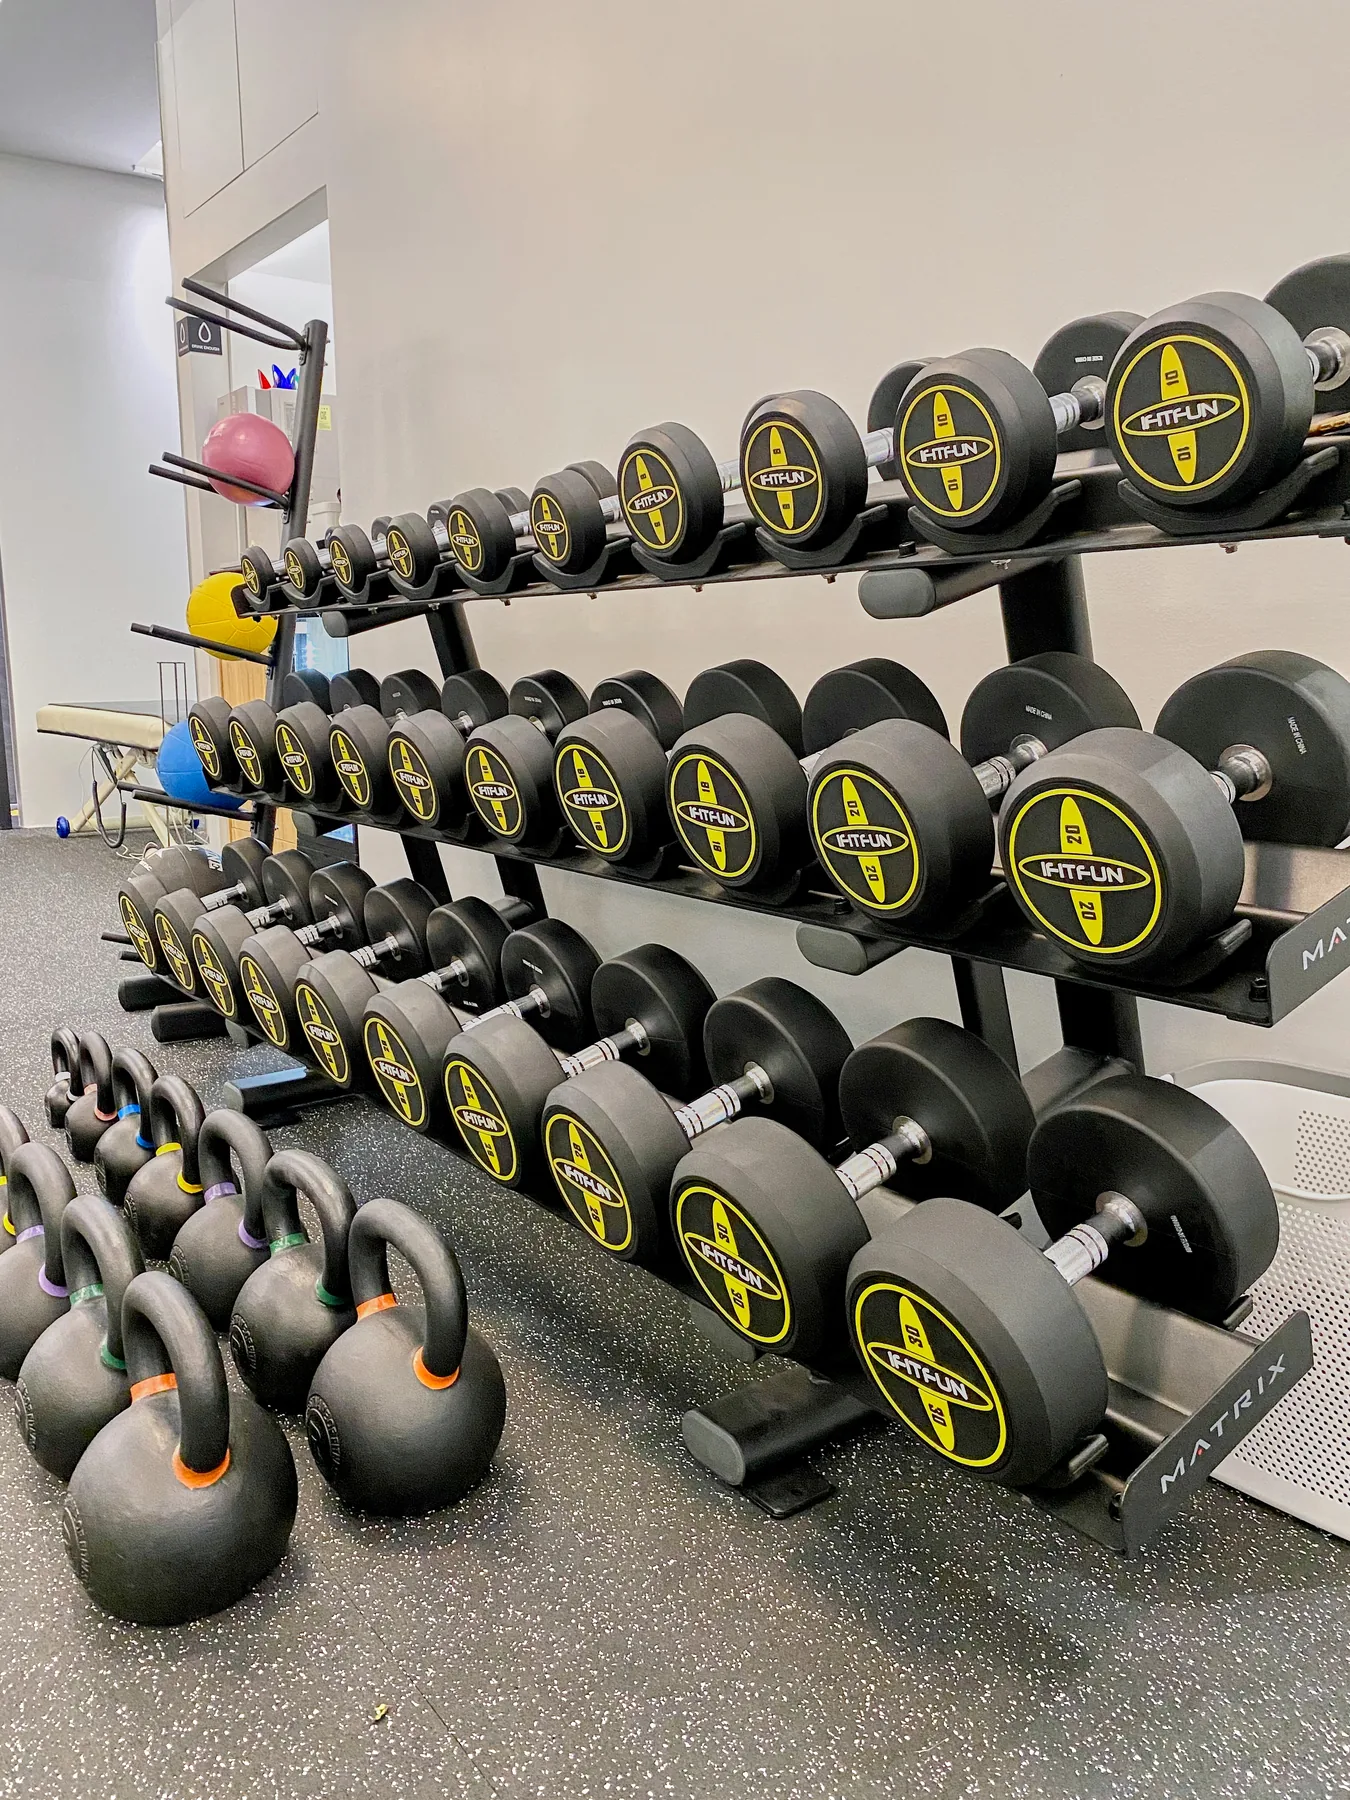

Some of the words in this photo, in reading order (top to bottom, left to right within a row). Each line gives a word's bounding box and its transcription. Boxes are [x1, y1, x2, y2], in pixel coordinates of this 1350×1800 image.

[1166, 370, 1180, 385] 10
[937, 414, 949, 428] 10
[1140, 400, 1219, 431] IFITFUN
[920, 442, 978, 462] IFITFUN
[1176, 446, 1191, 462] 10
[948, 478, 959, 491] 10
[847, 800, 860, 817] 20
[836, 834, 892, 848] IFITFUN
[1065, 824, 1082, 844] 20
[866, 865, 880, 882] 20
[1040, 861, 1124, 883] IFITFUN
[1079, 901, 1097, 920] 20
[717, 1222, 730, 1243] 30
[701, 1242, 762, 1290] IFITFUN
[731, 1288, 744, 1309] 30
[905, 1324, 924, 1348] 30
[887, 1350, 968, 1400] IFITFUN
[928, 1403, 947, 1427] 30
[1161, 1353, 1286, 1494] MATRIX
